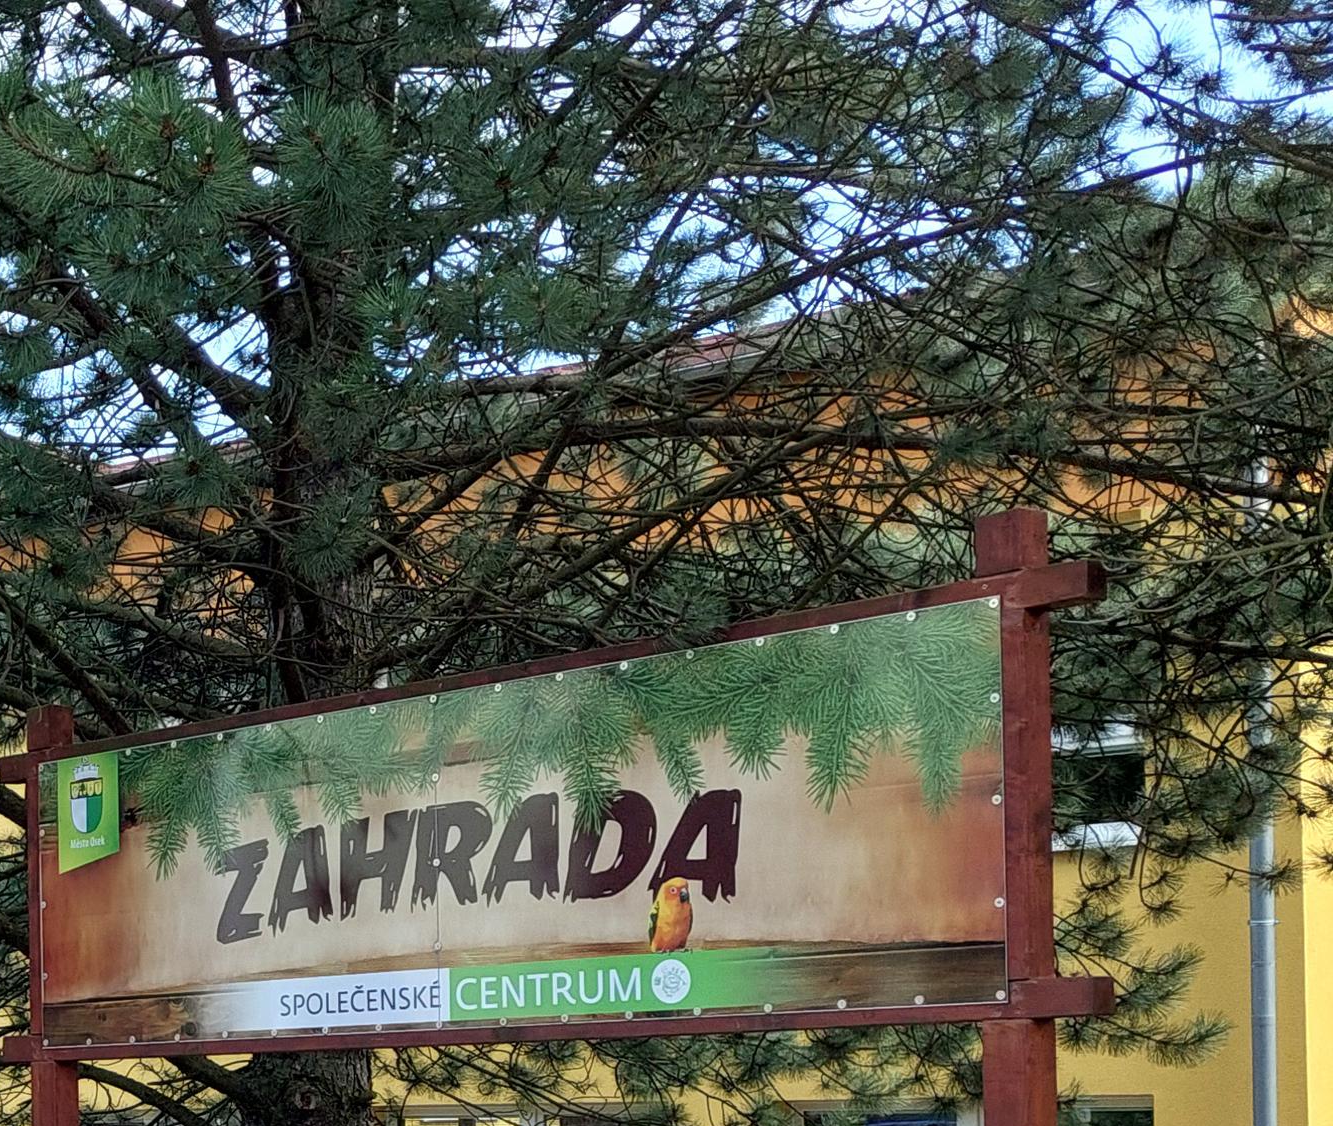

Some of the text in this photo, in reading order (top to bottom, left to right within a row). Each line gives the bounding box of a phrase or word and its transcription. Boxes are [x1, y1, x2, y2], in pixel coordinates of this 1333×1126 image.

[215, 788, 743, 944] ZAHRADA
[279, 967, 642, 1017] SPOLEČENSKÉ CENTRUM
